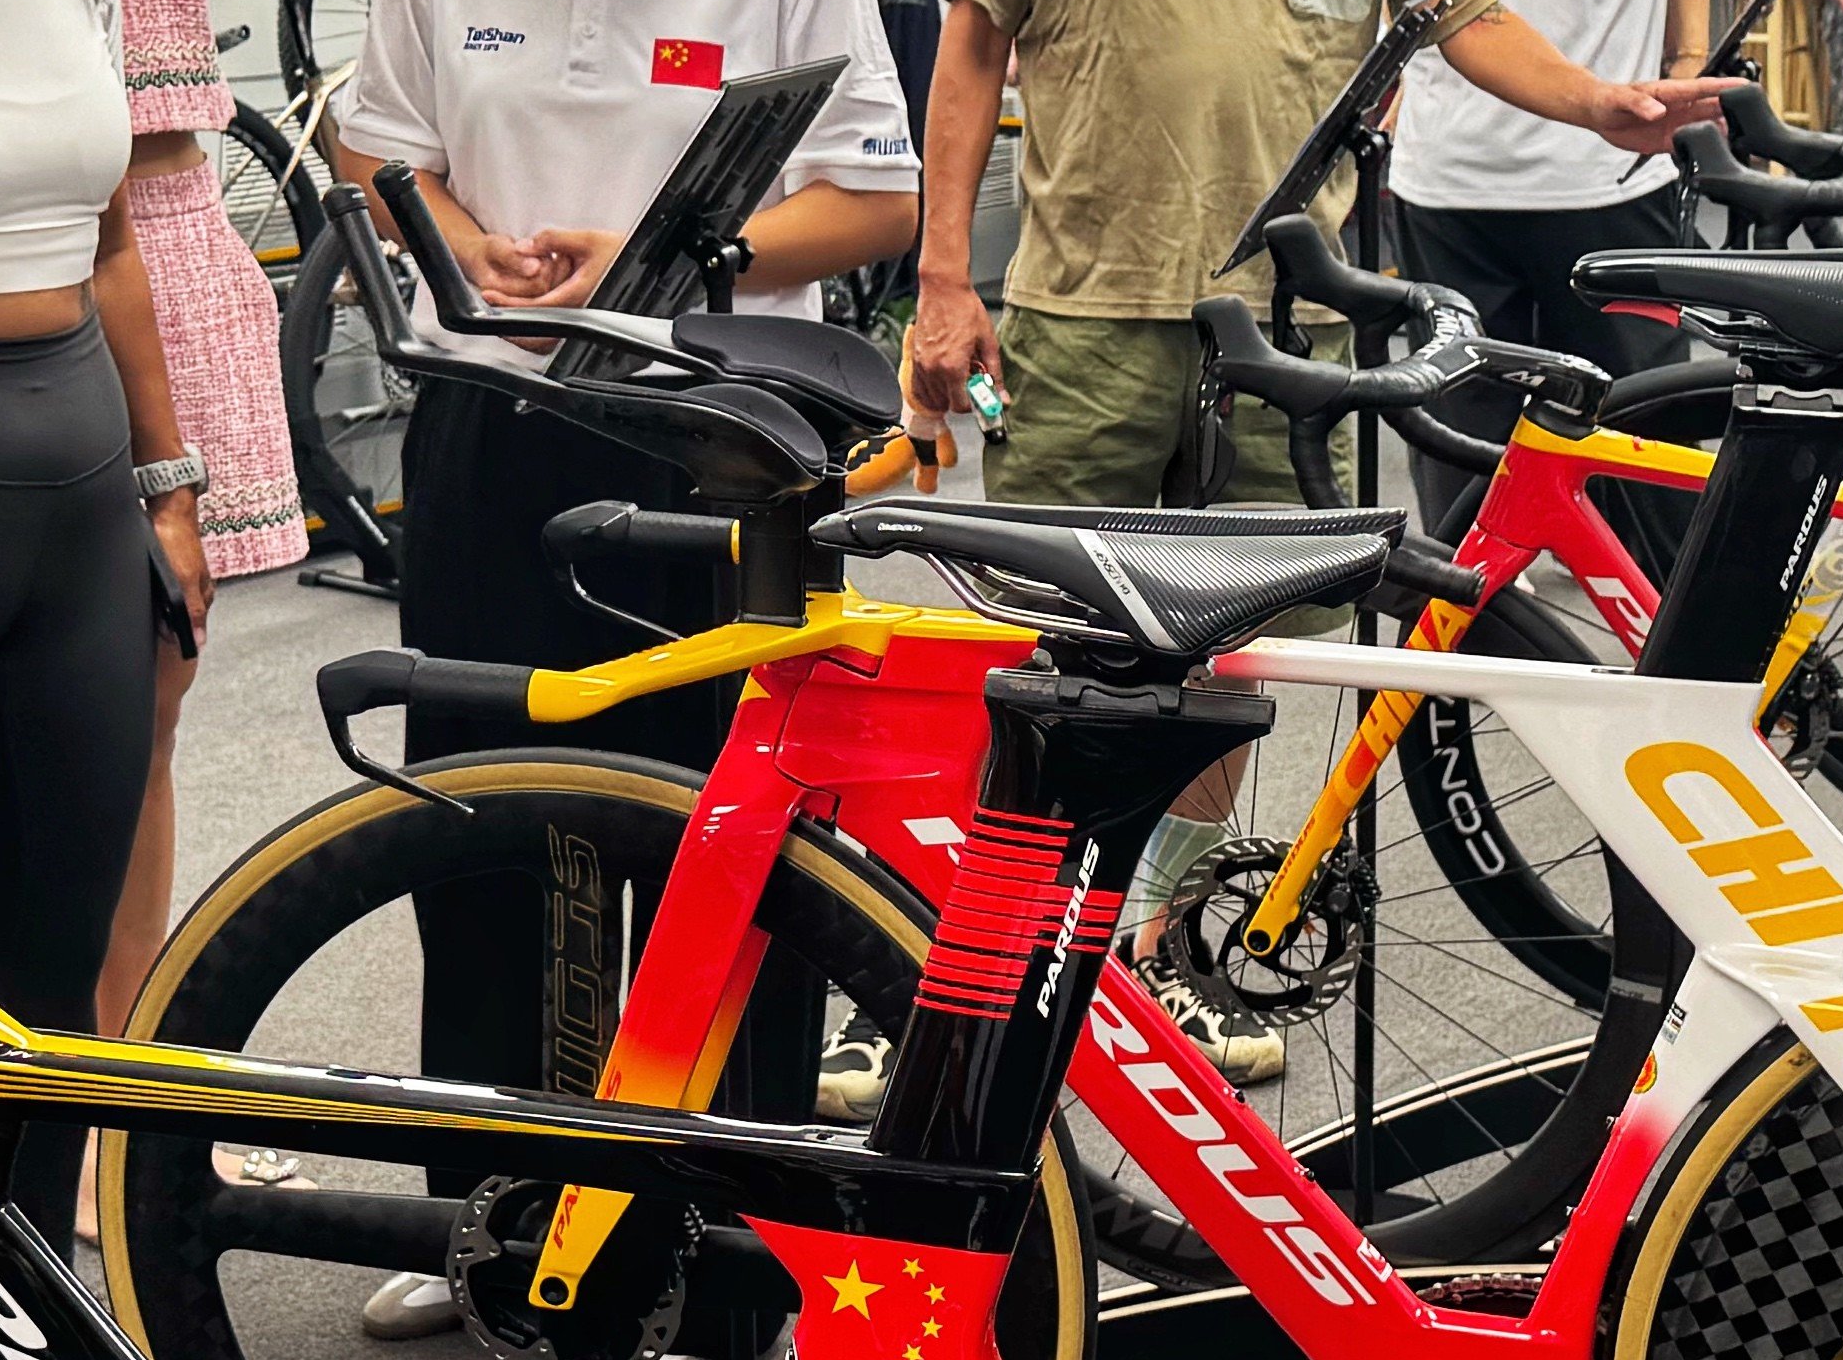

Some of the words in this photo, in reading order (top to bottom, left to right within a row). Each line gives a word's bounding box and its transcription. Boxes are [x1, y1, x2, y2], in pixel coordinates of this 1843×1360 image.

[1780, 474, 1827, 591] PARDUS
[1429, 695, 1505, 875] CONT
[1037, 838, 1100, 1019] PARDUS
